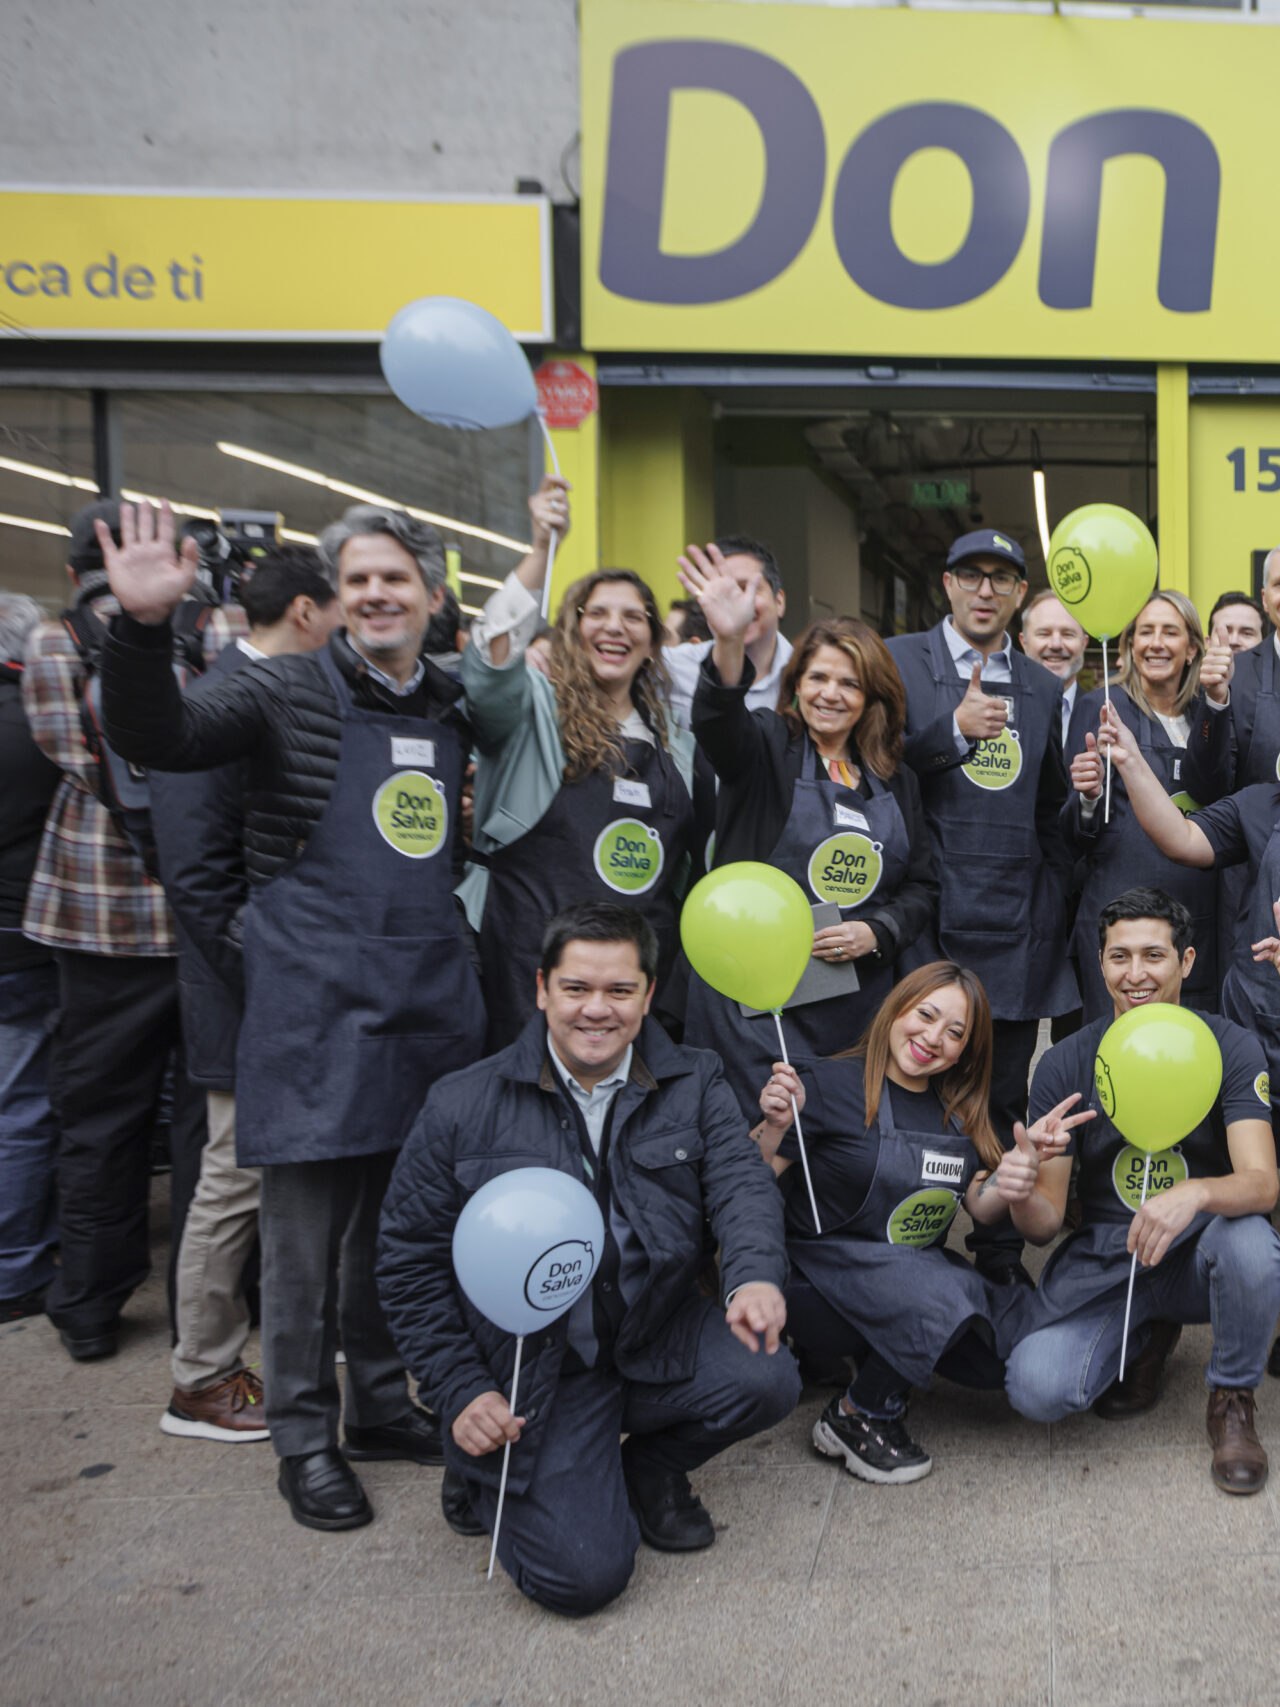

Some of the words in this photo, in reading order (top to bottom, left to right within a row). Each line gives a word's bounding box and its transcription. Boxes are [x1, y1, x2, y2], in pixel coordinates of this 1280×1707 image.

[596, 37, 1221, 313] Don
[0, 260, 71, 297] ca
[84, 251, 157, 300] de
[167, 254, 204, 301] ti
[971, 753, 1012, 770] Salva
[396, 791, 432, 811] Don
[390, 810, 437, 831] Salva
[616, 836, 646, 853] Don
[609, 852, 651, 870] Salva
[831, 850, 866, 868] Don
[821, 866, 867, 885] Salva
[1130, 1157, 1168, 1172] Don
[1125, 1174, 1174, 1190] Salva
[911, 1203, 946, 1217] Don
[900, 1217, 943, 1233] Salva
[549, 1260, 581, 1278] Don
[540, 1274, 582, 1293] Salva
